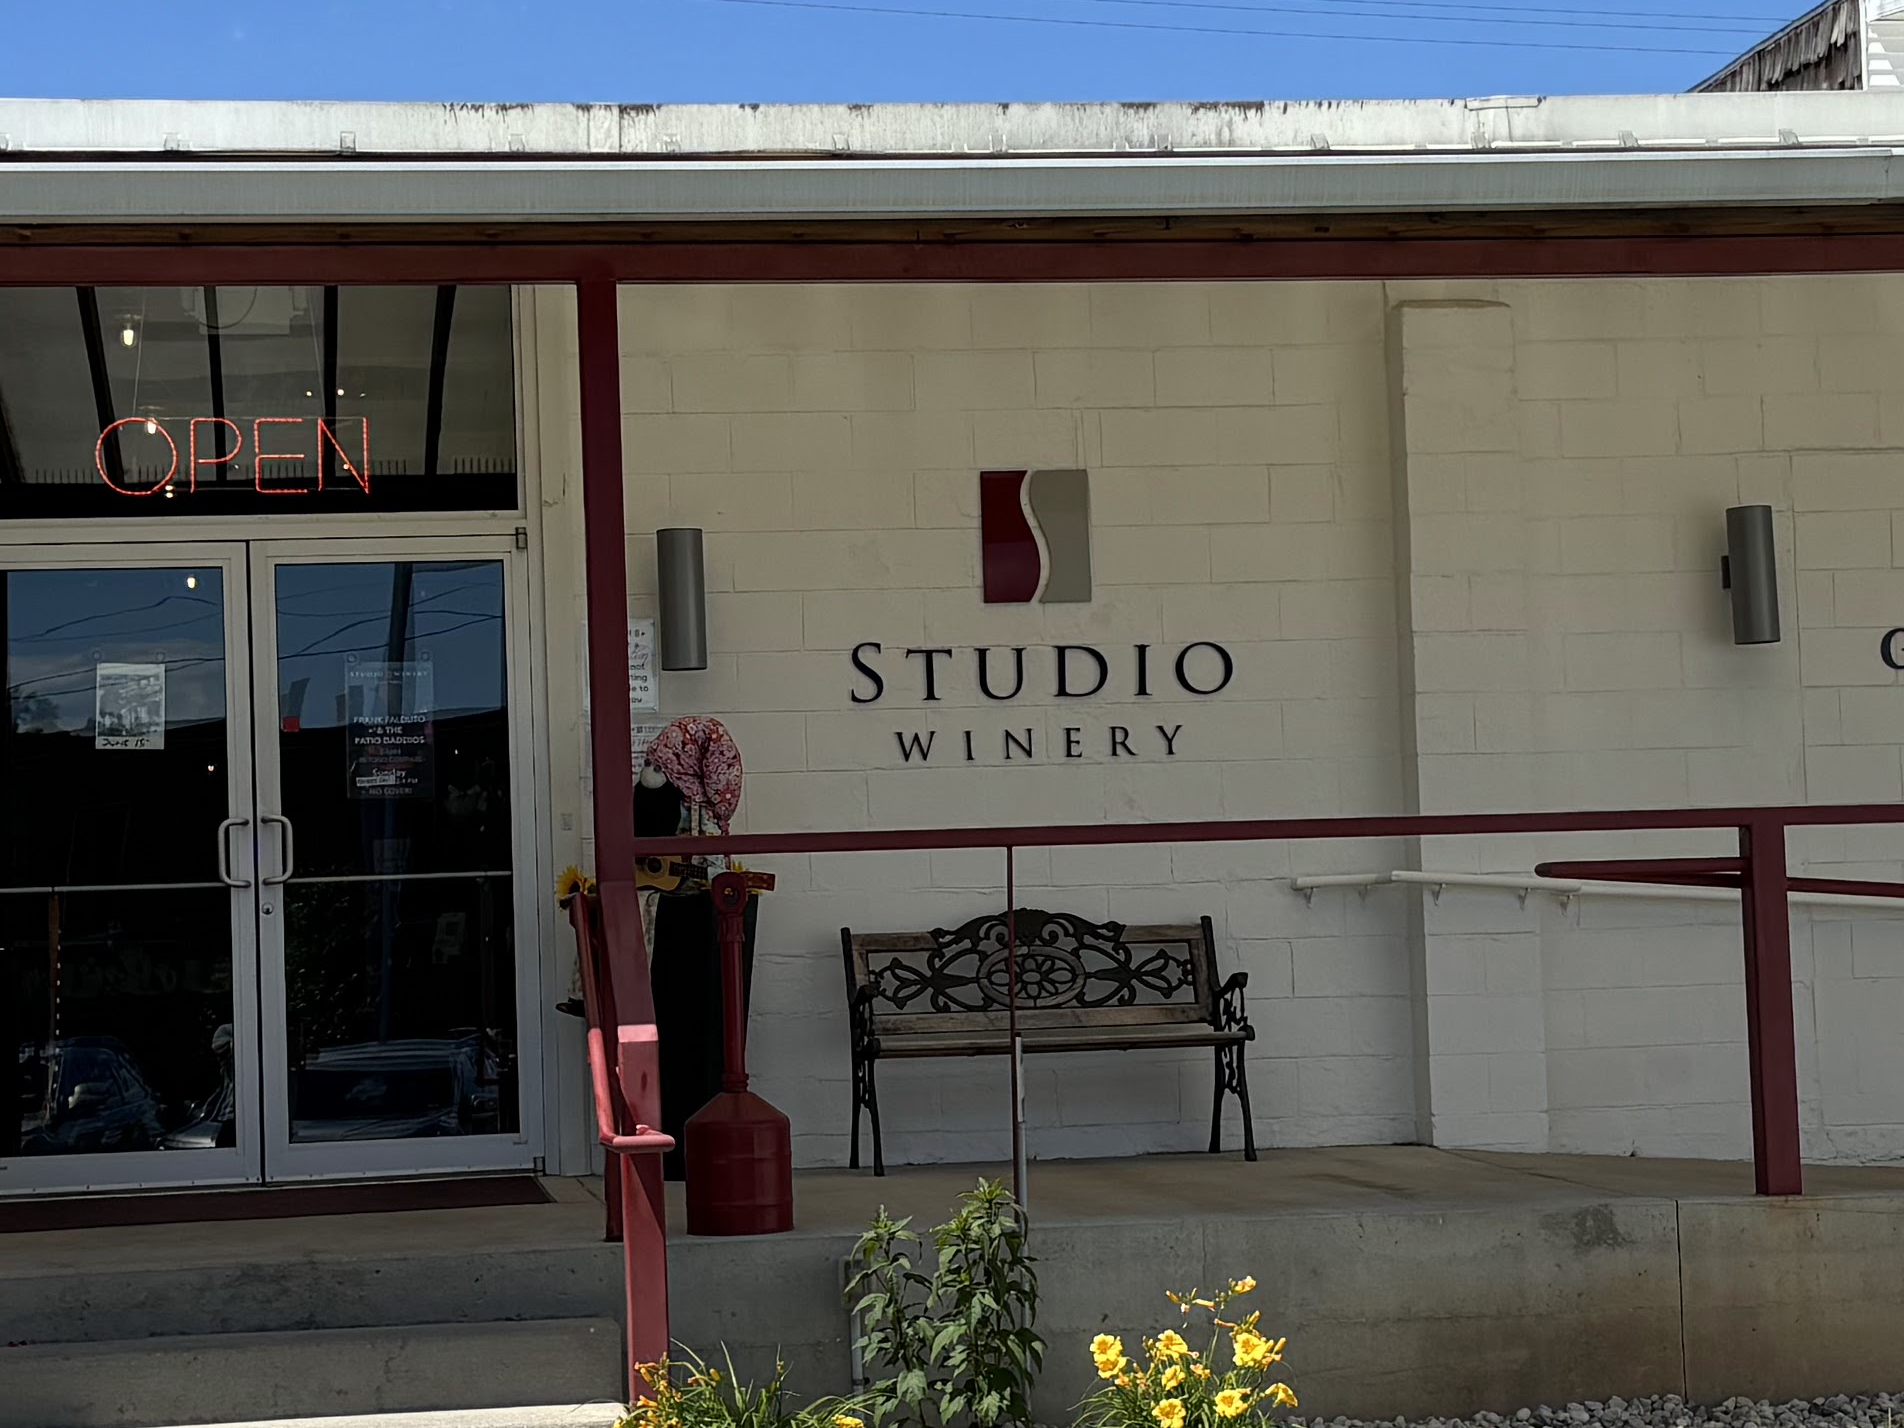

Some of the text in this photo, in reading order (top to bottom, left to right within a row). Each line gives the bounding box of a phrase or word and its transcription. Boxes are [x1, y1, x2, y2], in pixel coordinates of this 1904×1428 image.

[95, 417, 370, 495] OPEN
[850, 641, 1234, 704] STUDIO
[895, 724, 1183, 762] WINERY
